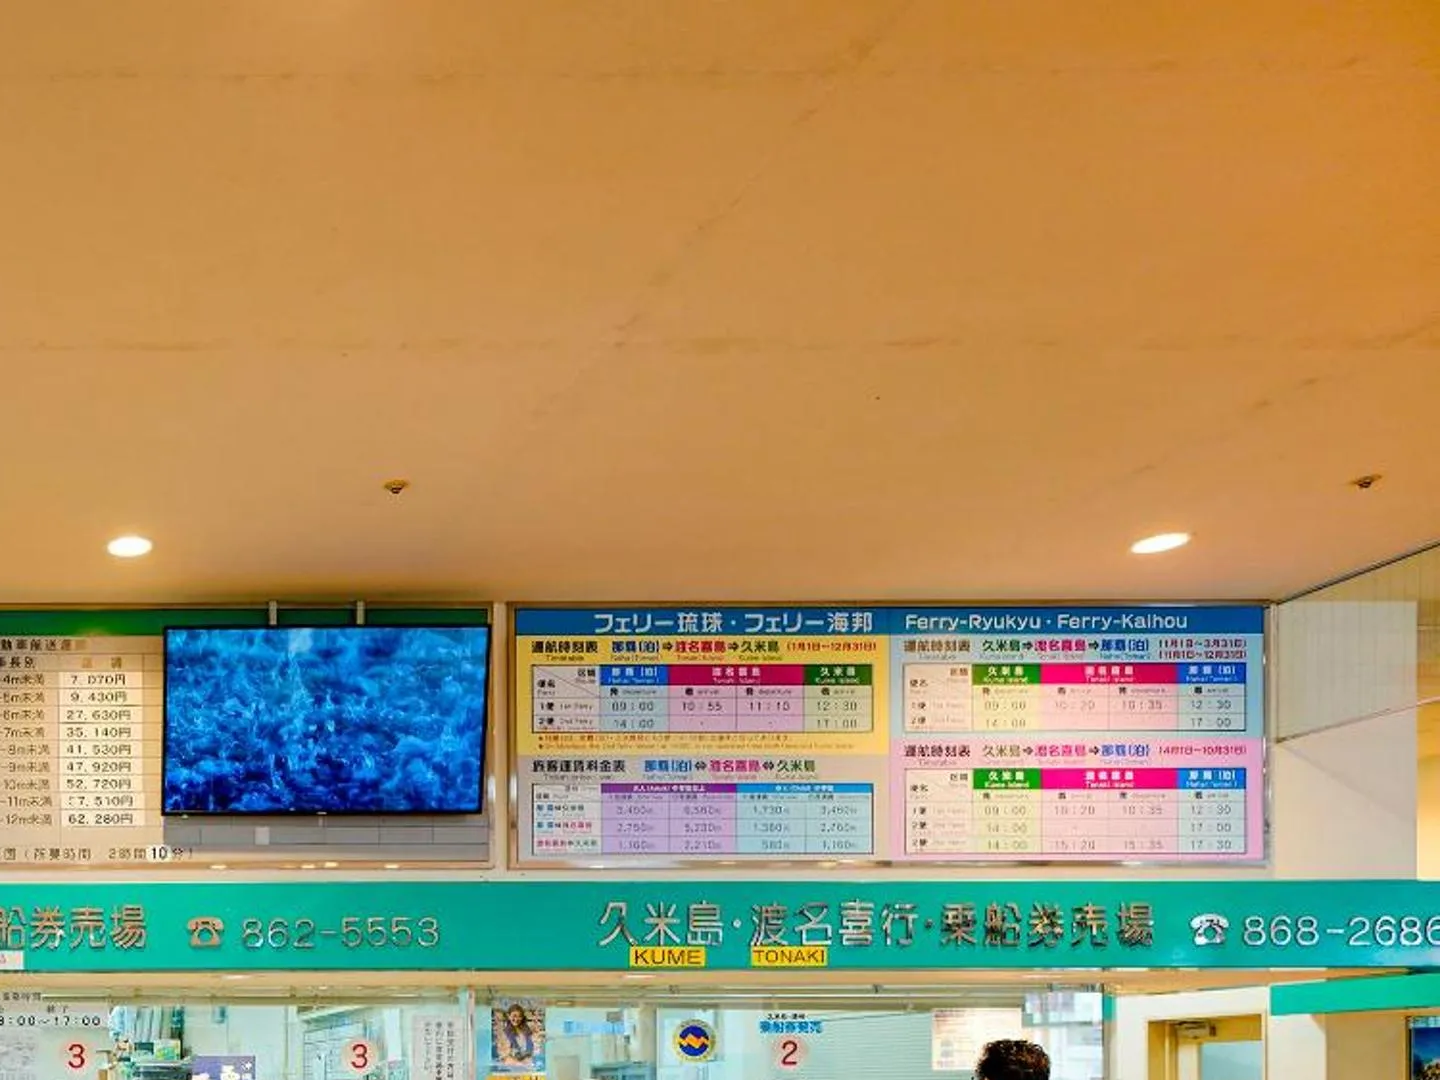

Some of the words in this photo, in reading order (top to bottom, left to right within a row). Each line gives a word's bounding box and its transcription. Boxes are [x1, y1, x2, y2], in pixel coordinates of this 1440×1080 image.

[594, 612, 873, 633] フェリー琉球・フェリー海邦
[242, 916, 440, 947] 862-5553
[598, 901, 1153, 949] 久米島・渡名喜行・乗船券売場
[634, 950, 702, 965] KUME
[753, 950, 826, 965] TONAKI
[68, 1044, 85, 1069] 3
[351, 1044, 368, 1069] 3
[782, 1040, 797, 1065] 2
